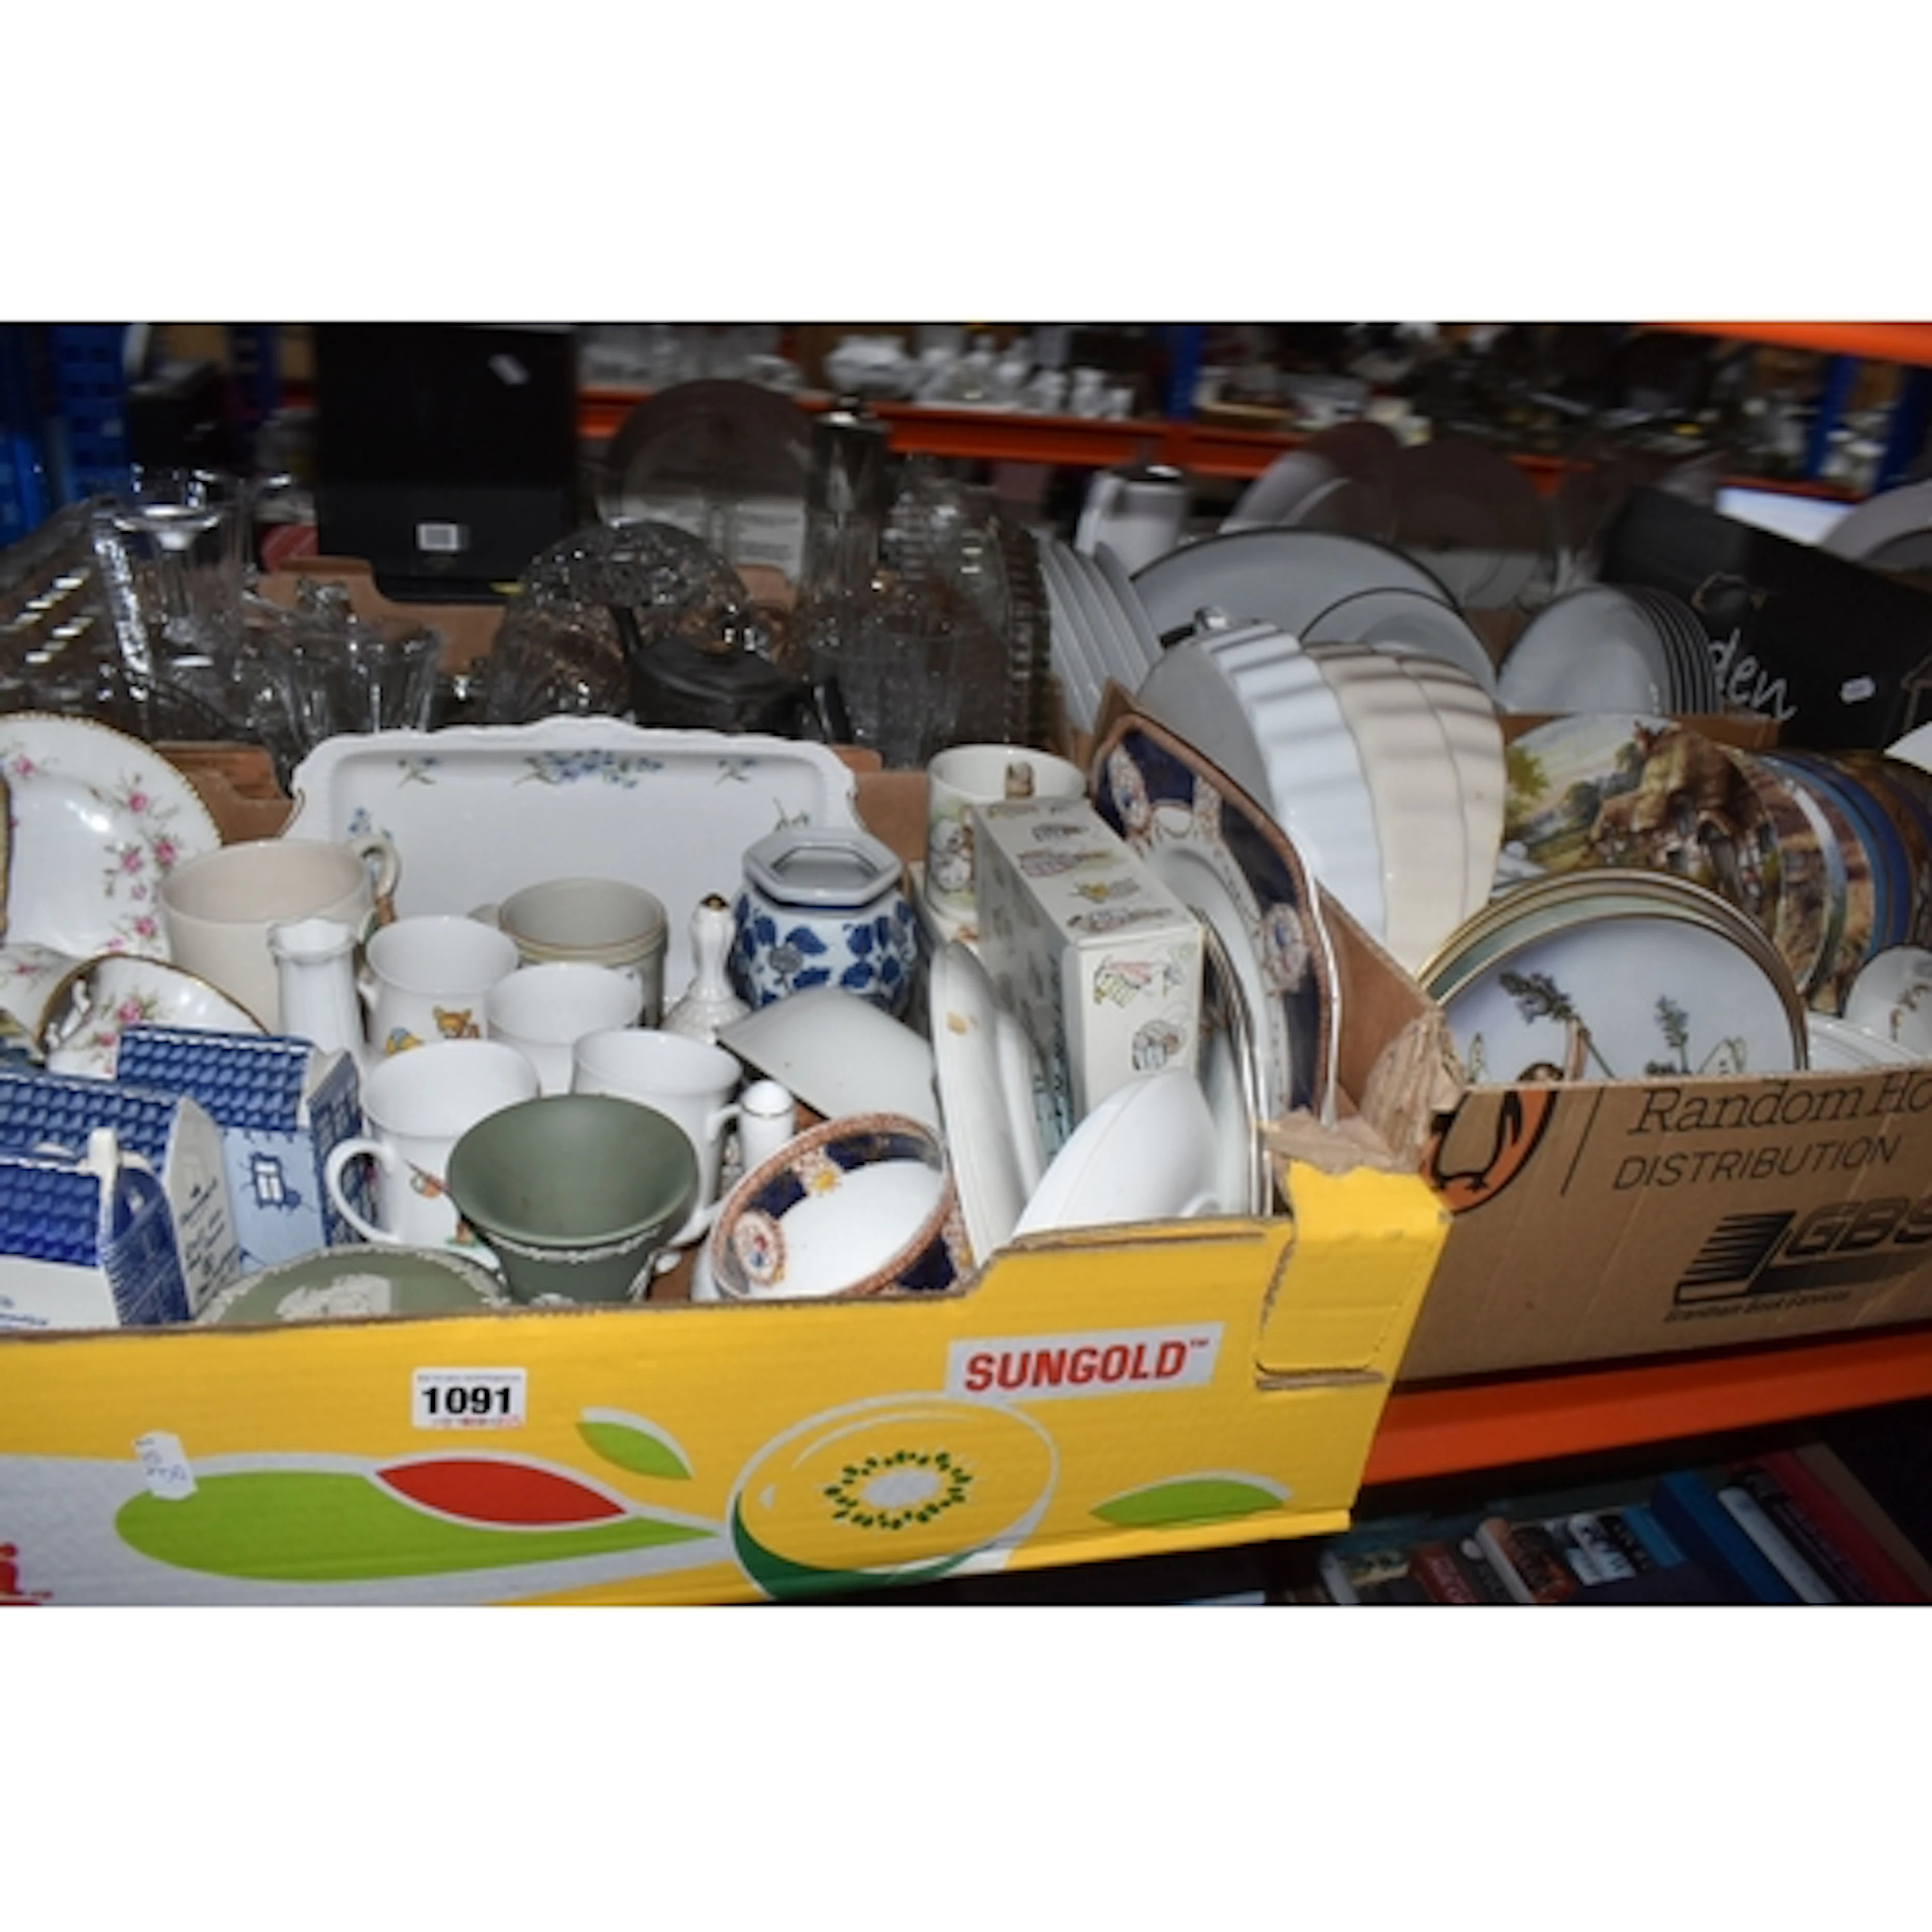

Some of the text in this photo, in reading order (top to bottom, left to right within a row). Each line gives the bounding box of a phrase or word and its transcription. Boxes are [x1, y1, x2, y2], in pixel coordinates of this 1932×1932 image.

[1627, 1078, 1864, 1135] Random
[1612, 1136, 1902, 1191] DISTRIBUTION
[965, 1340, 1188, 1393] SUNGOLD
[422, 1387, 510, 1414] 1091
